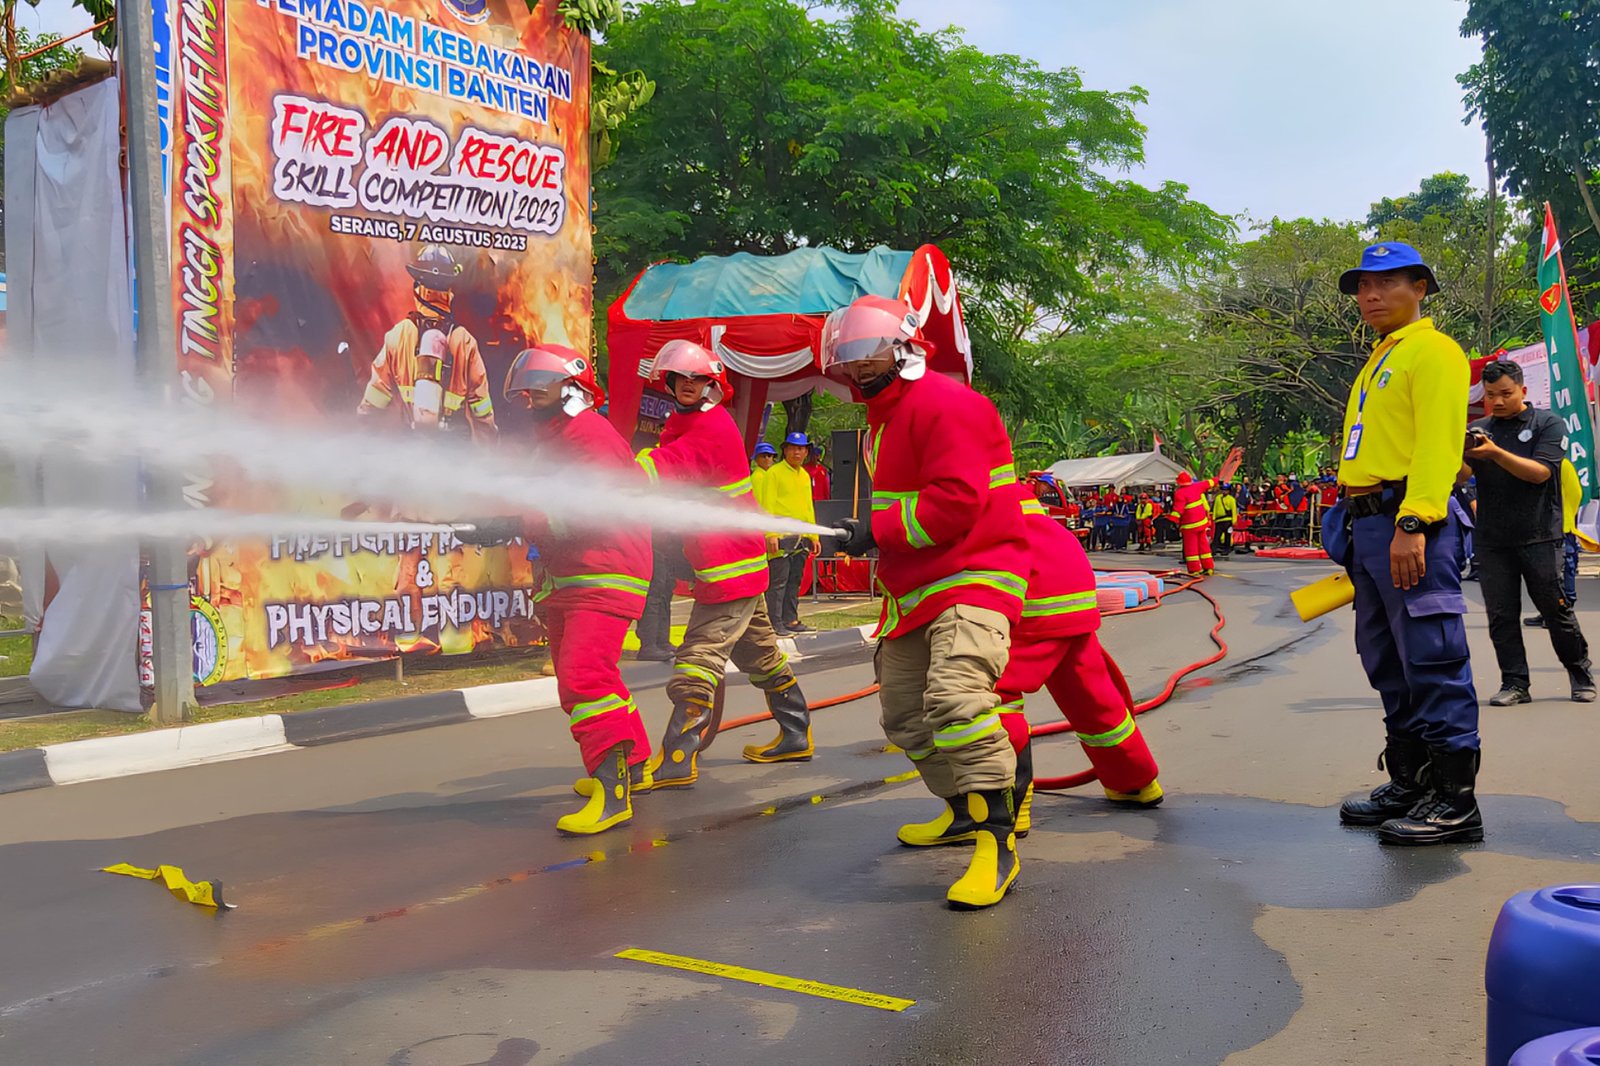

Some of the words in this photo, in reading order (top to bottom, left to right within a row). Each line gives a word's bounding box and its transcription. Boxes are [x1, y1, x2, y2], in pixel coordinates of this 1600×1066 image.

[300, 24, 440, 90] PROVINSI
[449, 67, 548, 121] BANTEN
[423, 22, 570, 99] KEBAKARAN
[280, 103, 358, 157] FIRE
[373, 125, 442, 170] AND
[458, 135, 560, 189] RESCUE
[281, 159, 351, 199] SKILL
[365, 173, 508, 220] COMPETITION
[514, 195, 560, 227] 2023
[405, 223, 417, 240] 7
[419, 225, 491, 247] AGUSTUS
[493, 233, 526, 251] 2023
[181, 226, 220, 359] TINGGI
[415, 559, 433, 588] &
[266, 595, 415, 648] PHYSICAL
